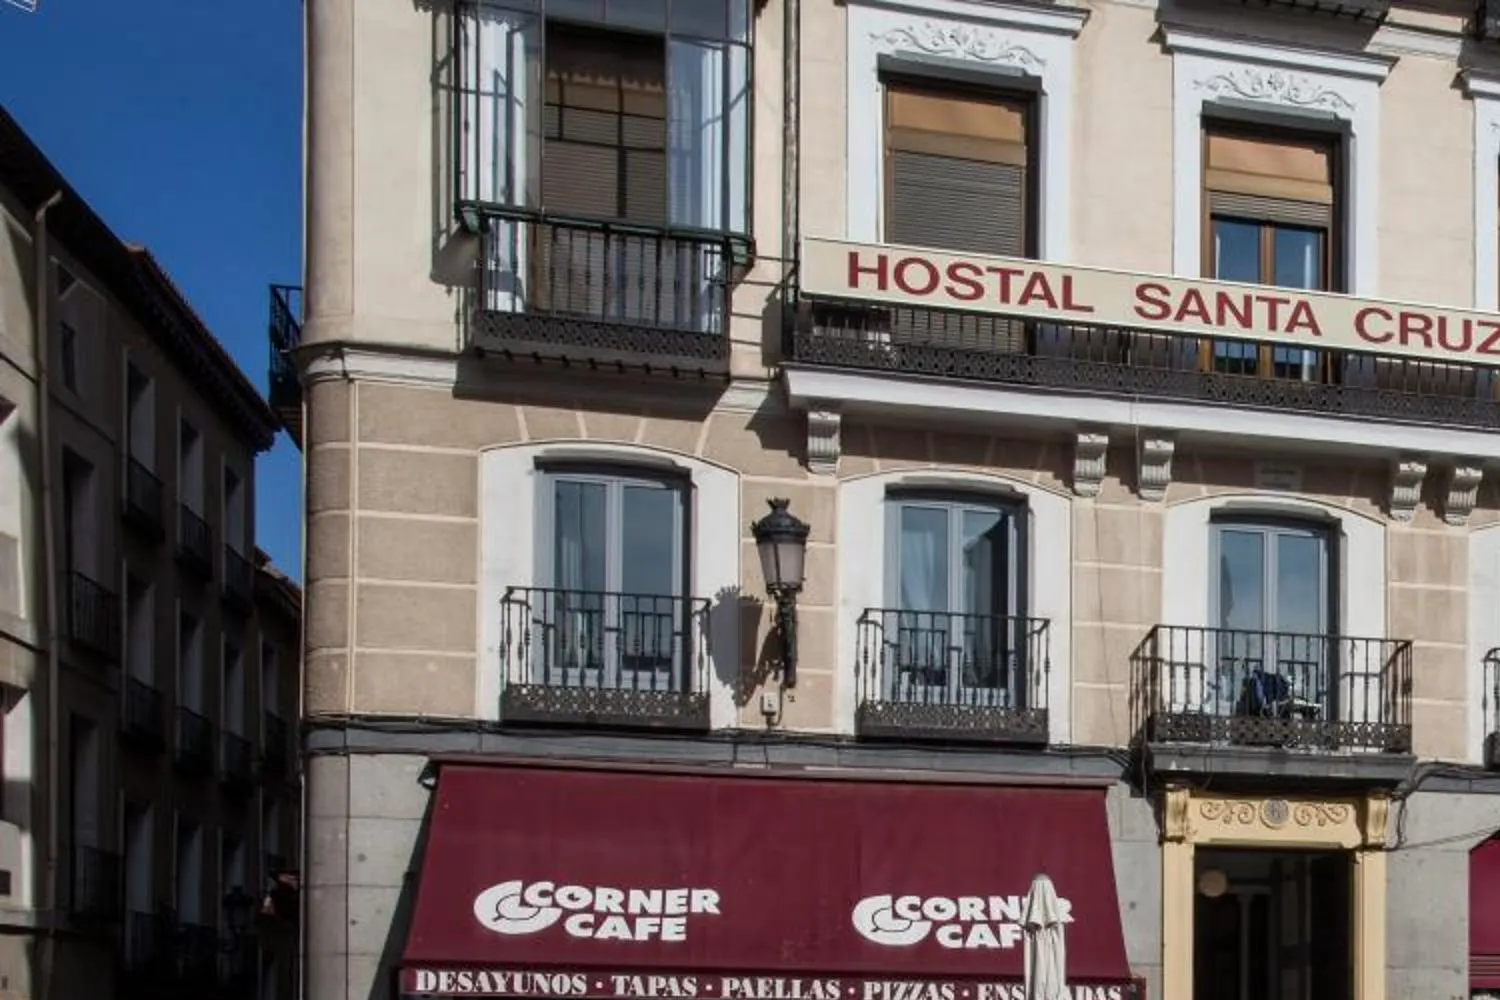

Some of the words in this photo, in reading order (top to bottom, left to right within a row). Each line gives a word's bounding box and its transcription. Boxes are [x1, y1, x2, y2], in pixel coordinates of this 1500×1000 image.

[847, 251, 1095, 313] HOSTAL
[1133, 282, 1322, 337] SANTA
[524, 881, 721, 915] CORNER
[894, 895, 1075, 923] CORNR
[564, 913, 687, 941] CAFE
[935, 923, 1023, 949] CAF
[415, 968, 588, 995] DESAYUNOS
[611, 975, 697, 997] TAPAS
[720, 977, 841, 1000] PAELLAS
